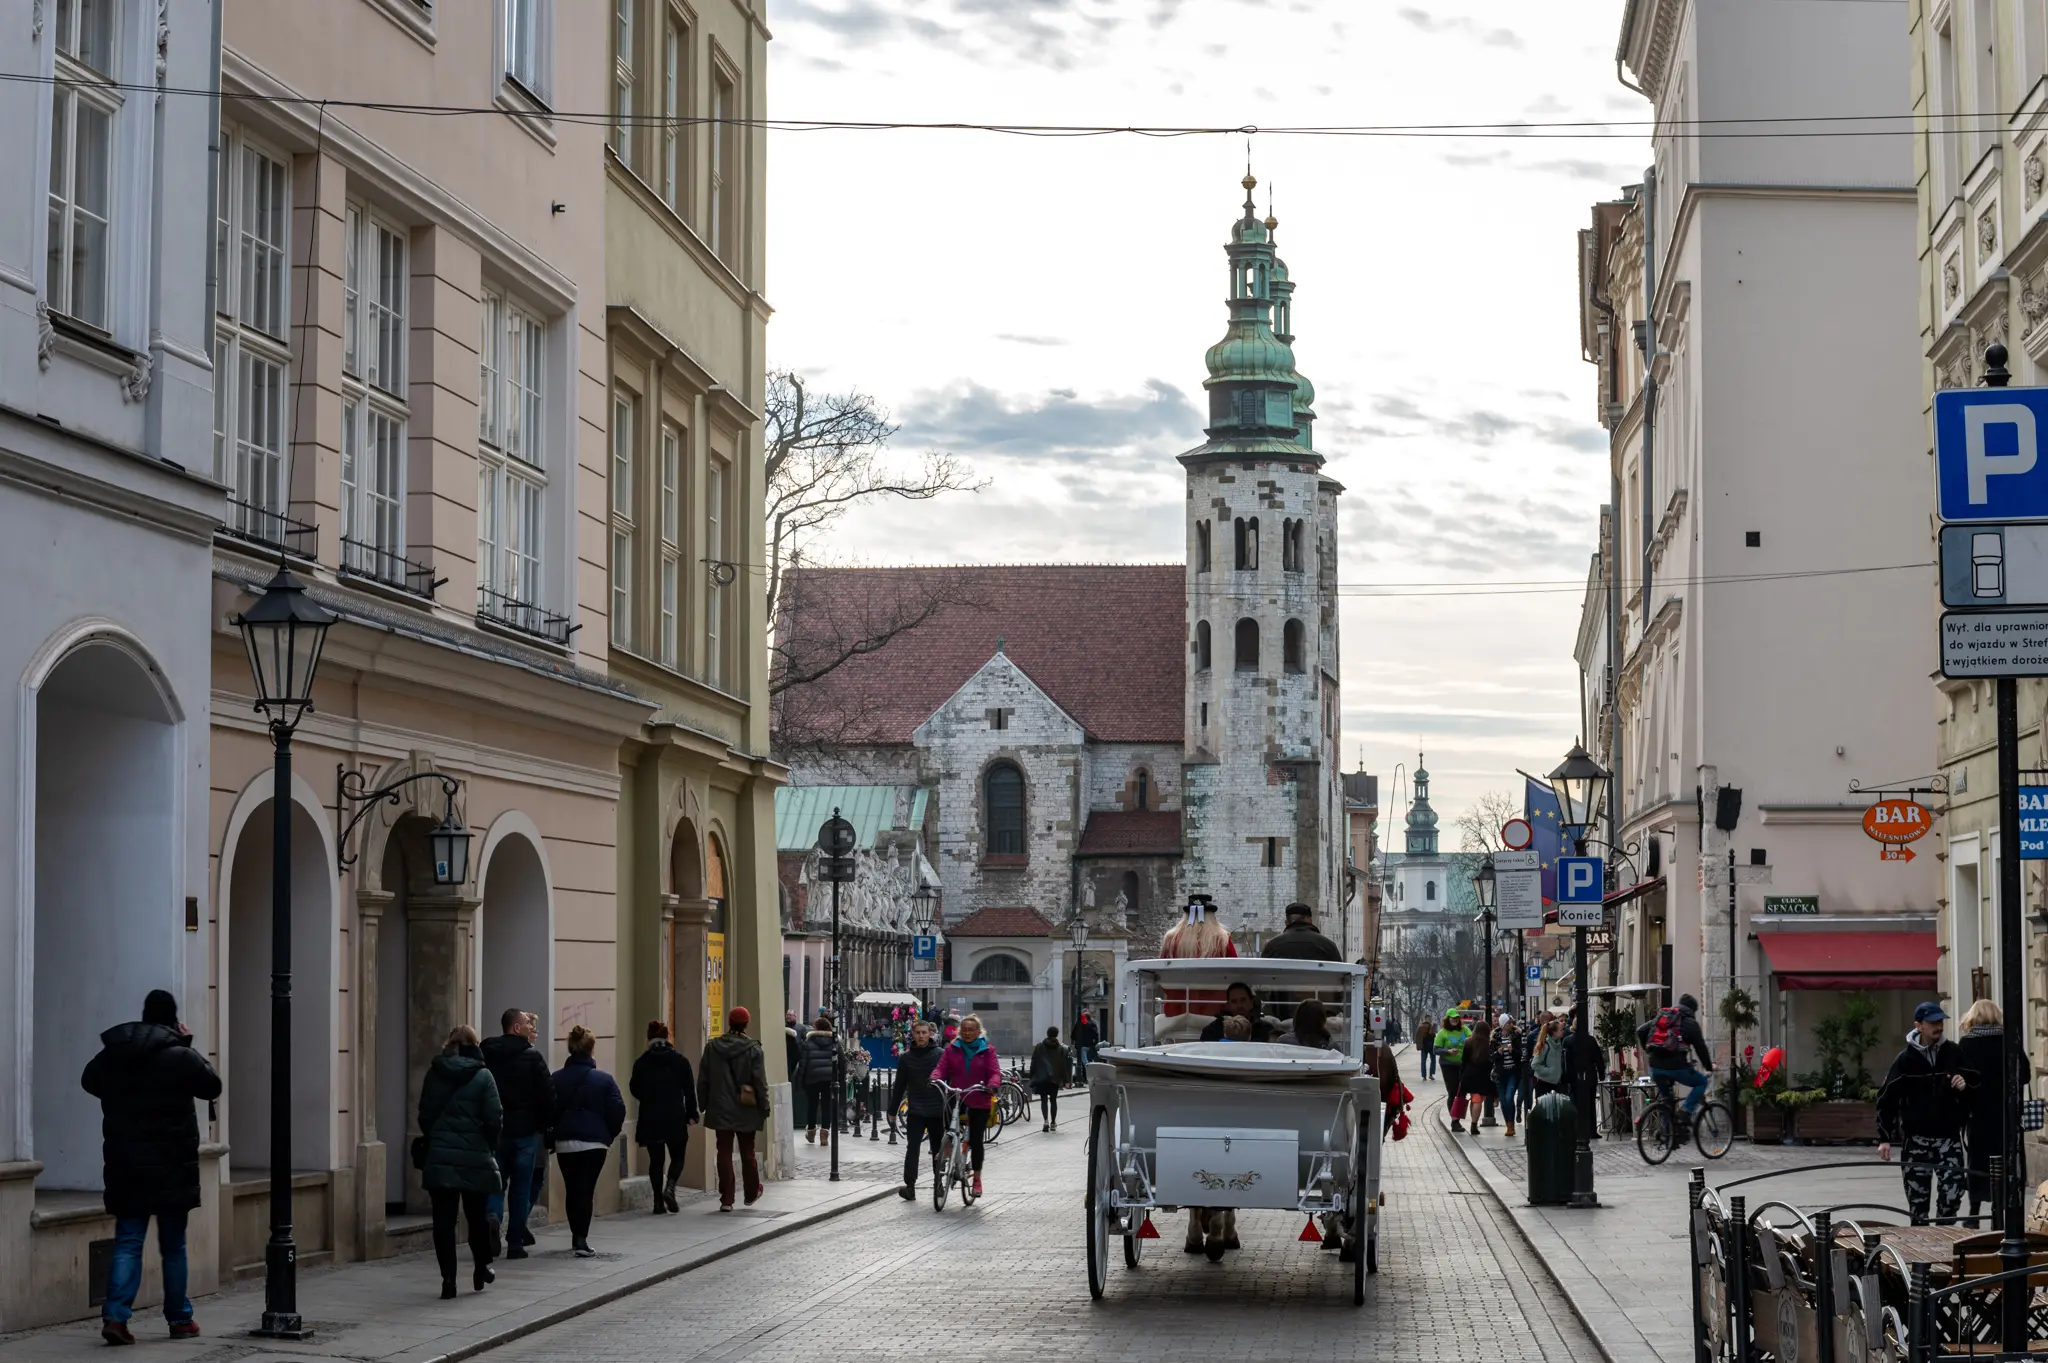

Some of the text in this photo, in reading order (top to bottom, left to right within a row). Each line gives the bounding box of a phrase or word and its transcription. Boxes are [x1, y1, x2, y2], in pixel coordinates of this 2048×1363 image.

[1964, 403, 2037, 504] P
[1946, 623, 1970, 635] Wył.
[1974, 623, 1991, 632] dla
[1950, 640, 1963, 649] do
[1968, 639, 2005, 651] wjazdu
[1953, 656, 2007, 668] wyjątkiem
[1875, 806, 1921, 823] BAR
[2020, 841, 2044, 850] Pod
[1568, 862, 1593, 897] P
[1767, 903, 1816, 913] SENACKA
[1560, 909, 1600, 920] Koniec
[1586, 932, 1610, 944] BAR
[918, 938, 931, 955] P
[1530, 967, 1538, 977] P
[288, 1250, 294, 1262] 5
